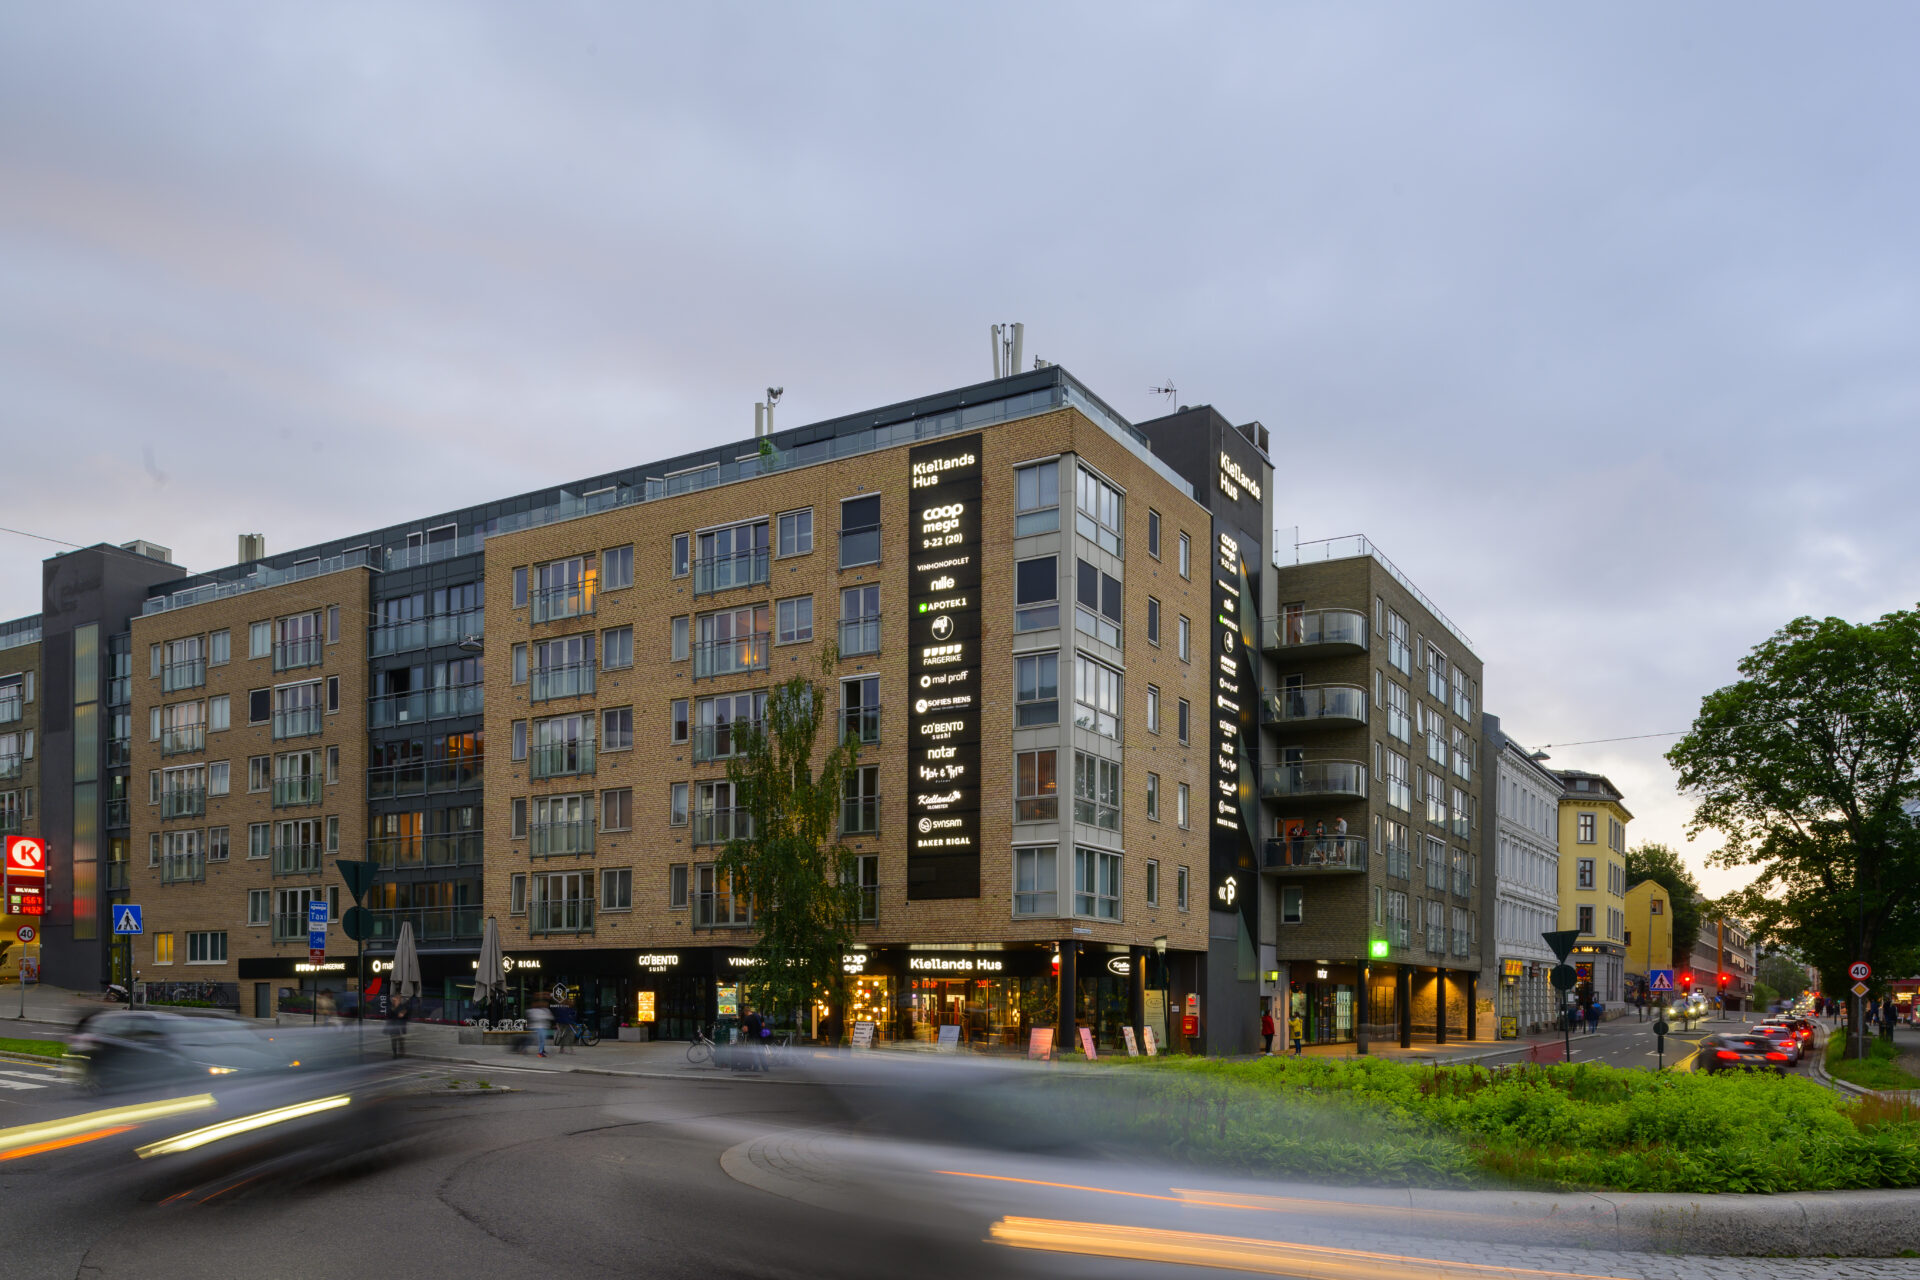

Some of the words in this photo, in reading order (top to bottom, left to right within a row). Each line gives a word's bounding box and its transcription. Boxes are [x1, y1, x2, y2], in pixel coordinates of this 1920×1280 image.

[913, 453, 975, 476] Kiellands
[913, 475, 938, 488] Hus
[1220, 451, 1260, 500] Kiellands
[1220, 472, 1238, 500] Hus
[923, 503, 964, 521] coop
[923, 518, 960, 533] mega
[923, 537, 943, 549] 9-22
[945, 533, 963, 546] (20)
[1221, 533, 1238, 553] coop
[917, 557, 969, 571] VINMONOPOLET
[931, 575, 955, 591] nille
[928, 598, 962, 611] APOTEK
[923, 654, 962, 666] FARGERIKE
[921, 720, 964, 735] GO'BENTO
[927, 745, 957, 760] notar
[918, 839, 943, 847] BAKER
[946, 837, 970, 845] RIGAL
[21, 846, 37, 865] K
[1226, 885, 1235, 905] P
[311, 912, 326, 920] Taxi
[20, 929, 33, 939] 40
[518, 960, 541, 968] RIGAL
[639, 954, 678, 965] GO'BENTO
[842, 954, 867, 965] oop
[910, 958, 973, 970] Kiellands
[976, 959, 1003, 970] Hus
[843, 964, 864, 974] ega
[1852, 966, 1868, 976] 40
